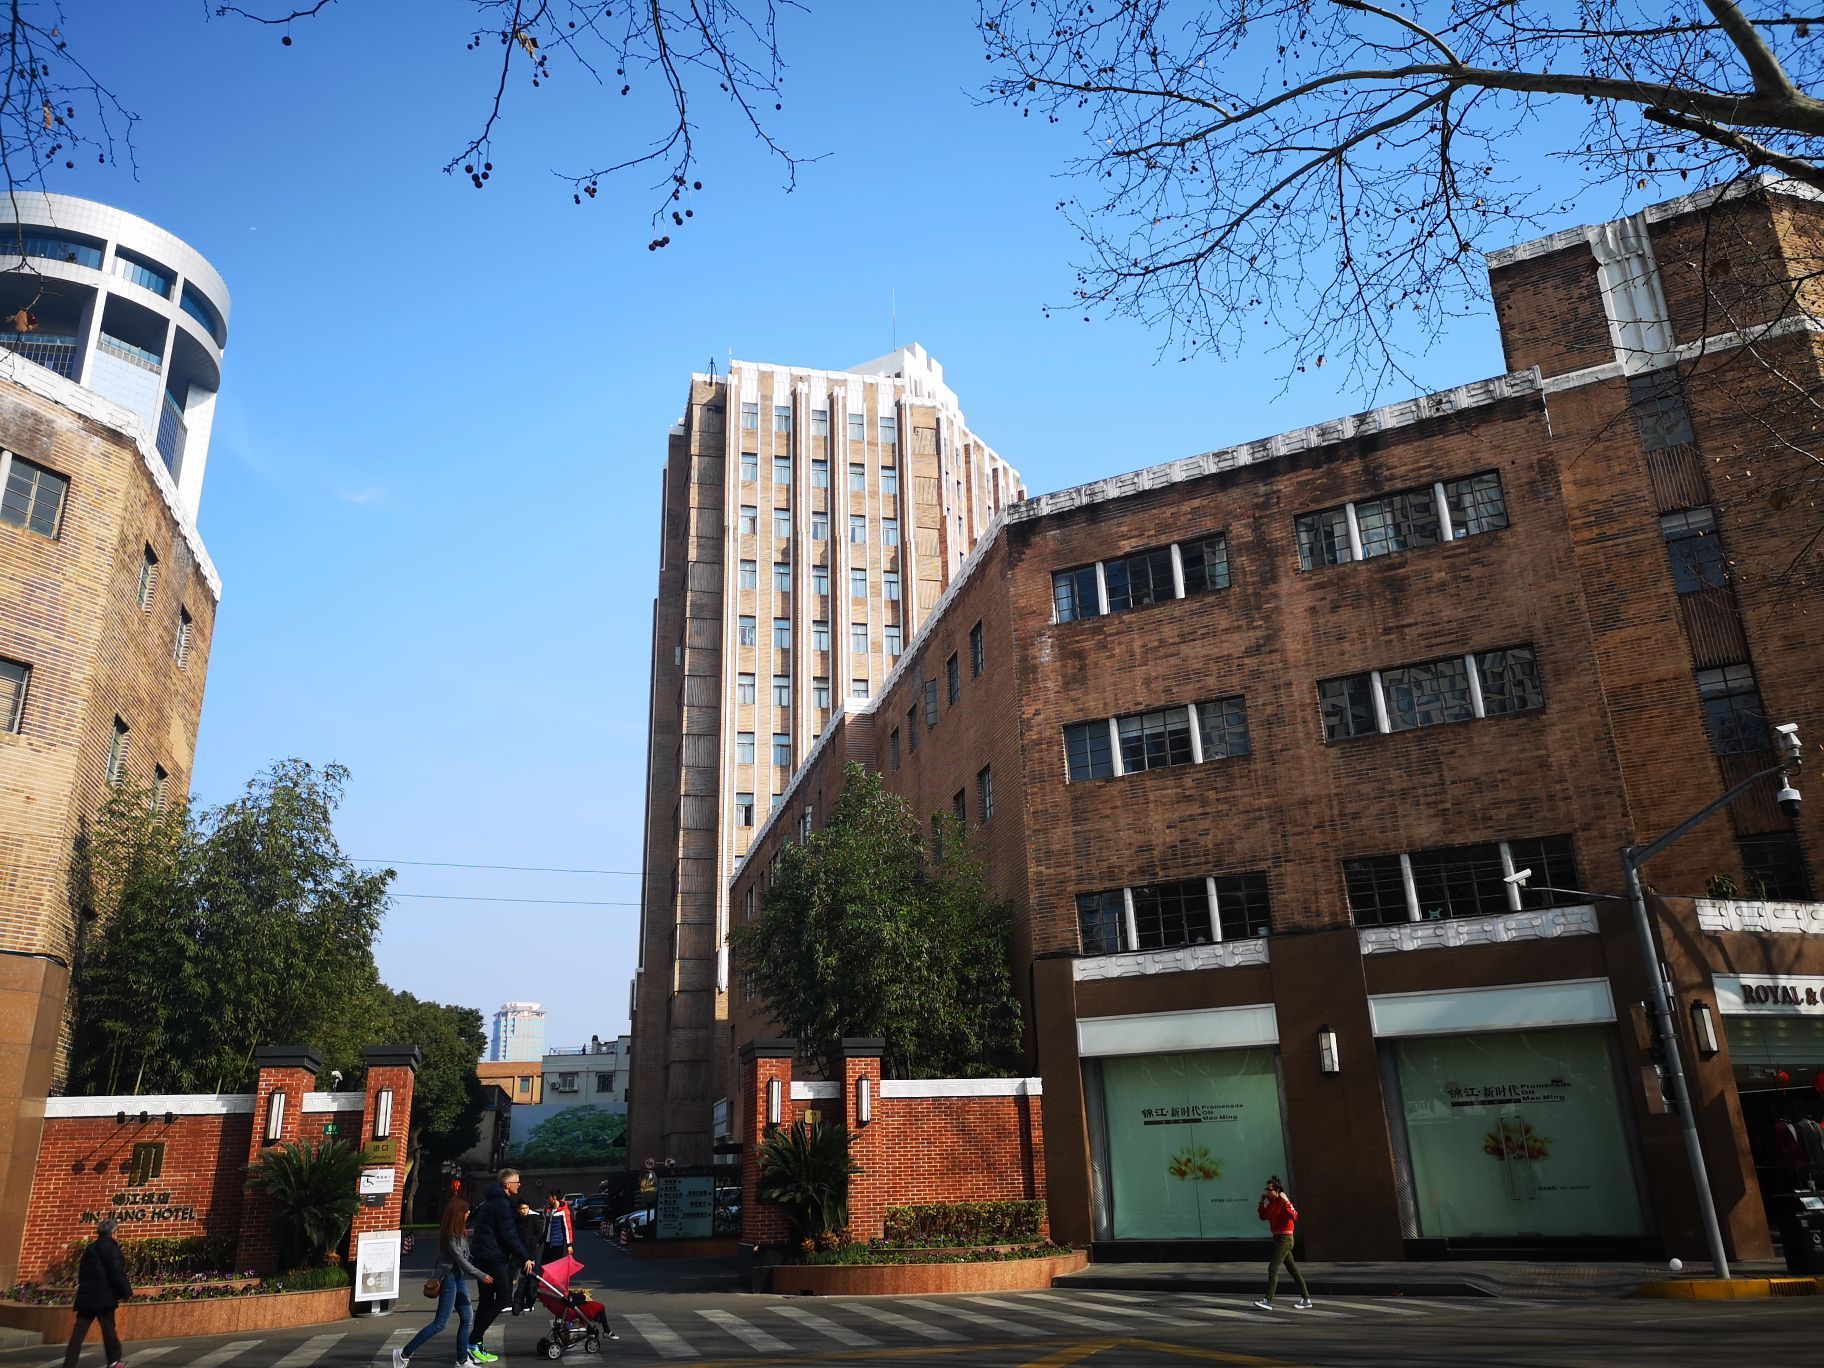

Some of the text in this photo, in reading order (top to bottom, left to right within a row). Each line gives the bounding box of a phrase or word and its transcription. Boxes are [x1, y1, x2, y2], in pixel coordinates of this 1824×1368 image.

[1741, 984, 1804, 1005] ROYAL
[1805, 987, 1820, 1006] &
[80, 1207, 196, 1223] JIN JIANG HOTEL
